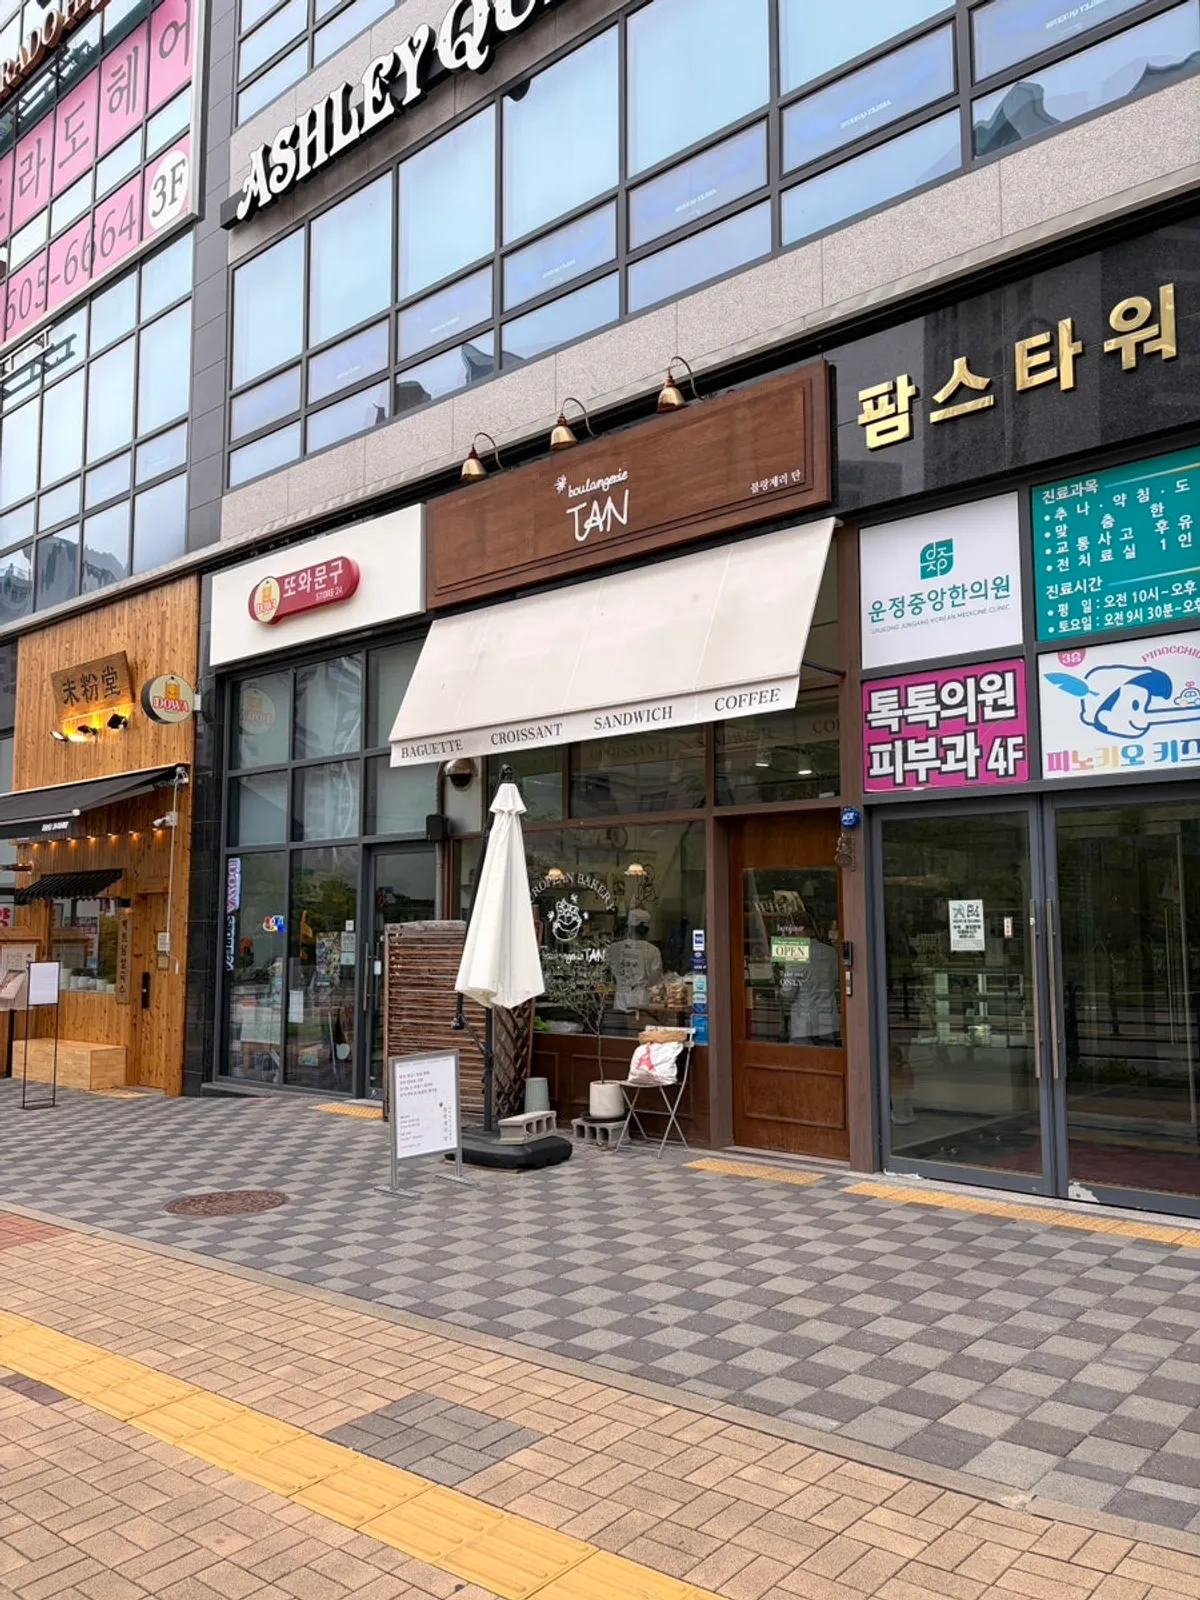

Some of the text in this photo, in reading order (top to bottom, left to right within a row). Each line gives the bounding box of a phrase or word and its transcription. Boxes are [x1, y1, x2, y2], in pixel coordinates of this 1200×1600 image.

[0, 0, 192, 220] 라도헤어
[236, 23, 430, 220] ASHLEY
[152, 158, 187, 218] 3F
[857, 282, 1177, 450] 팜스타워
[568, 467, 629, 498] boulangerie
[1042, 479, 1098, 505] 진료과목
[566, 488, 630, 541] TAN
[283, 560, 343, 598] 또와문구
[868, 574, 1011, 624] 운정중앙한의원
[1046, 575, 1103, 600] 진료시간
[930, 613, 956, 625] KOREAN
[957, 608, 988, 619] MEDICINE
[1058, 615, 1092, 633] 토요일
[401, 687, 781, 759] BAGUETTE CROISSANT SANDWICH COFFEE
[866, 671, 1016, 732] 톡톡의원
[868, 731, 1024, 785] 피부과 4F
[1046, 743, 1146, 773] 피노키오
[775, 945, 805, 956] OPEN
